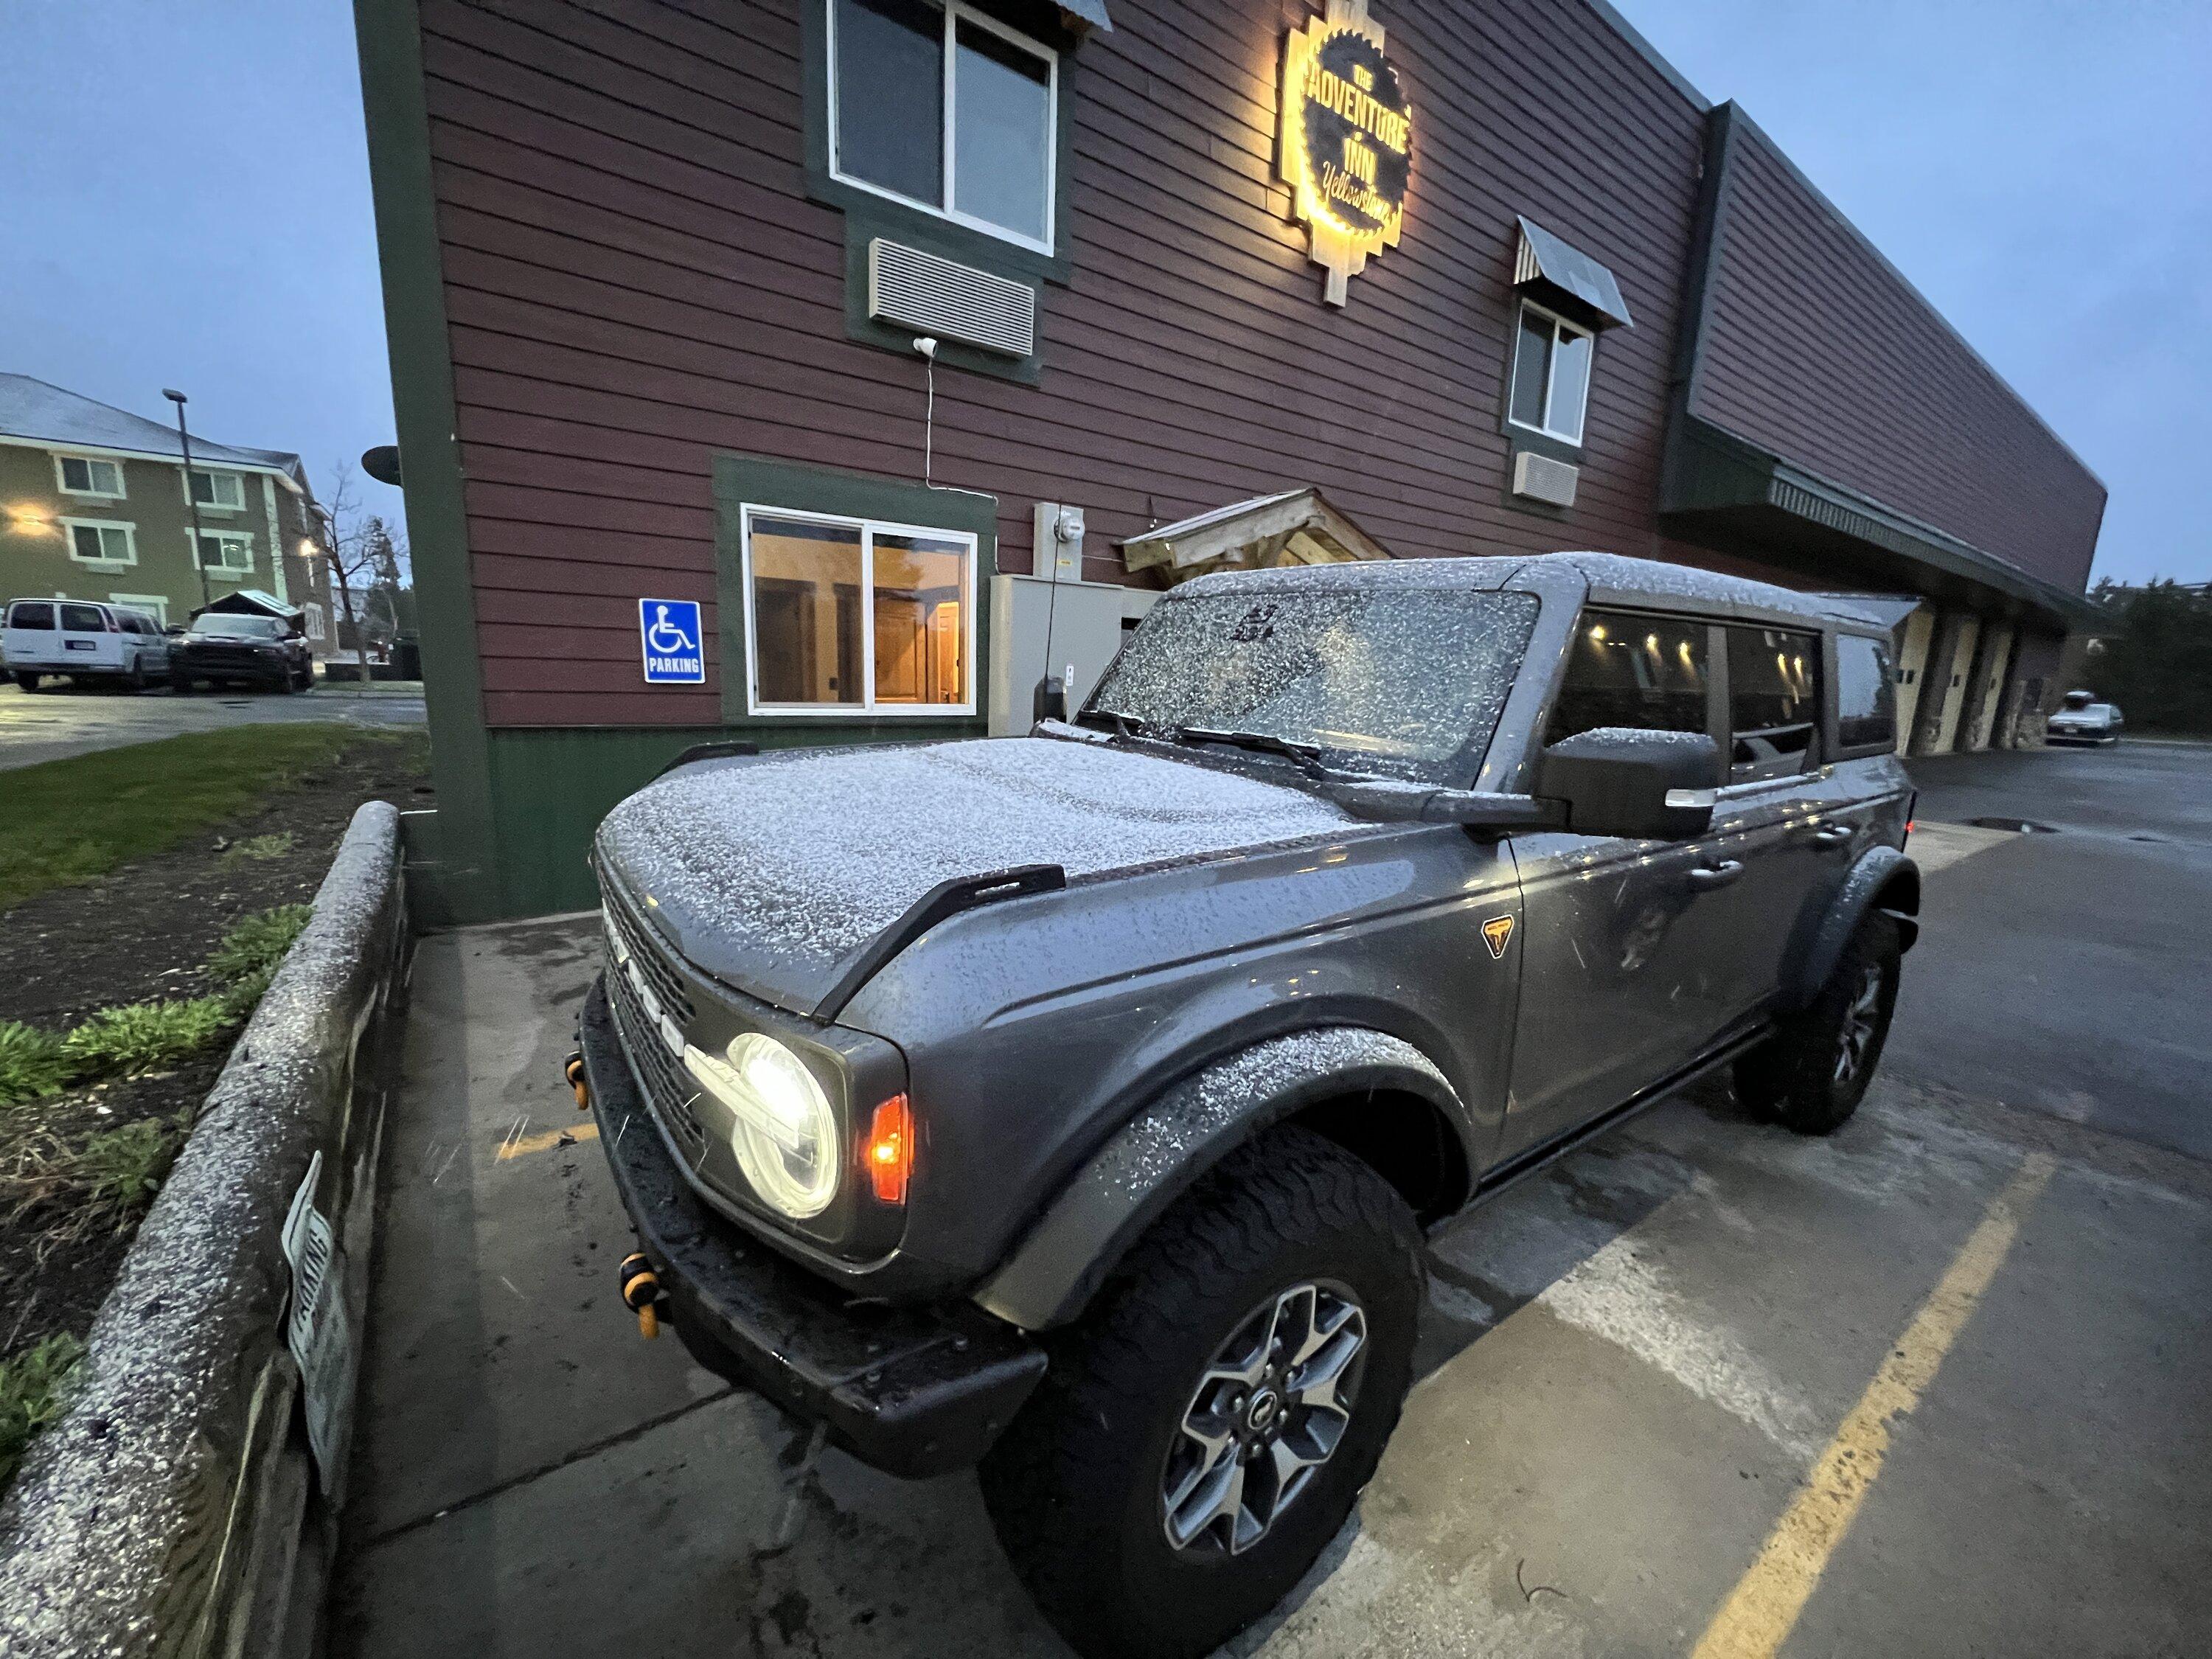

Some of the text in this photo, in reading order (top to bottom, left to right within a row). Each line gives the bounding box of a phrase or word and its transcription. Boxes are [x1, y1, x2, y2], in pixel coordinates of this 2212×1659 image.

[1354, 64, 1374, 91] THE
[1307, 61, 1410, 155] ADVENTURE
[1344, 136, 1377, 185] INN
[1323, 161, 1393, 224] Yellowstone
[649, 657, 699, 673] PARKING
